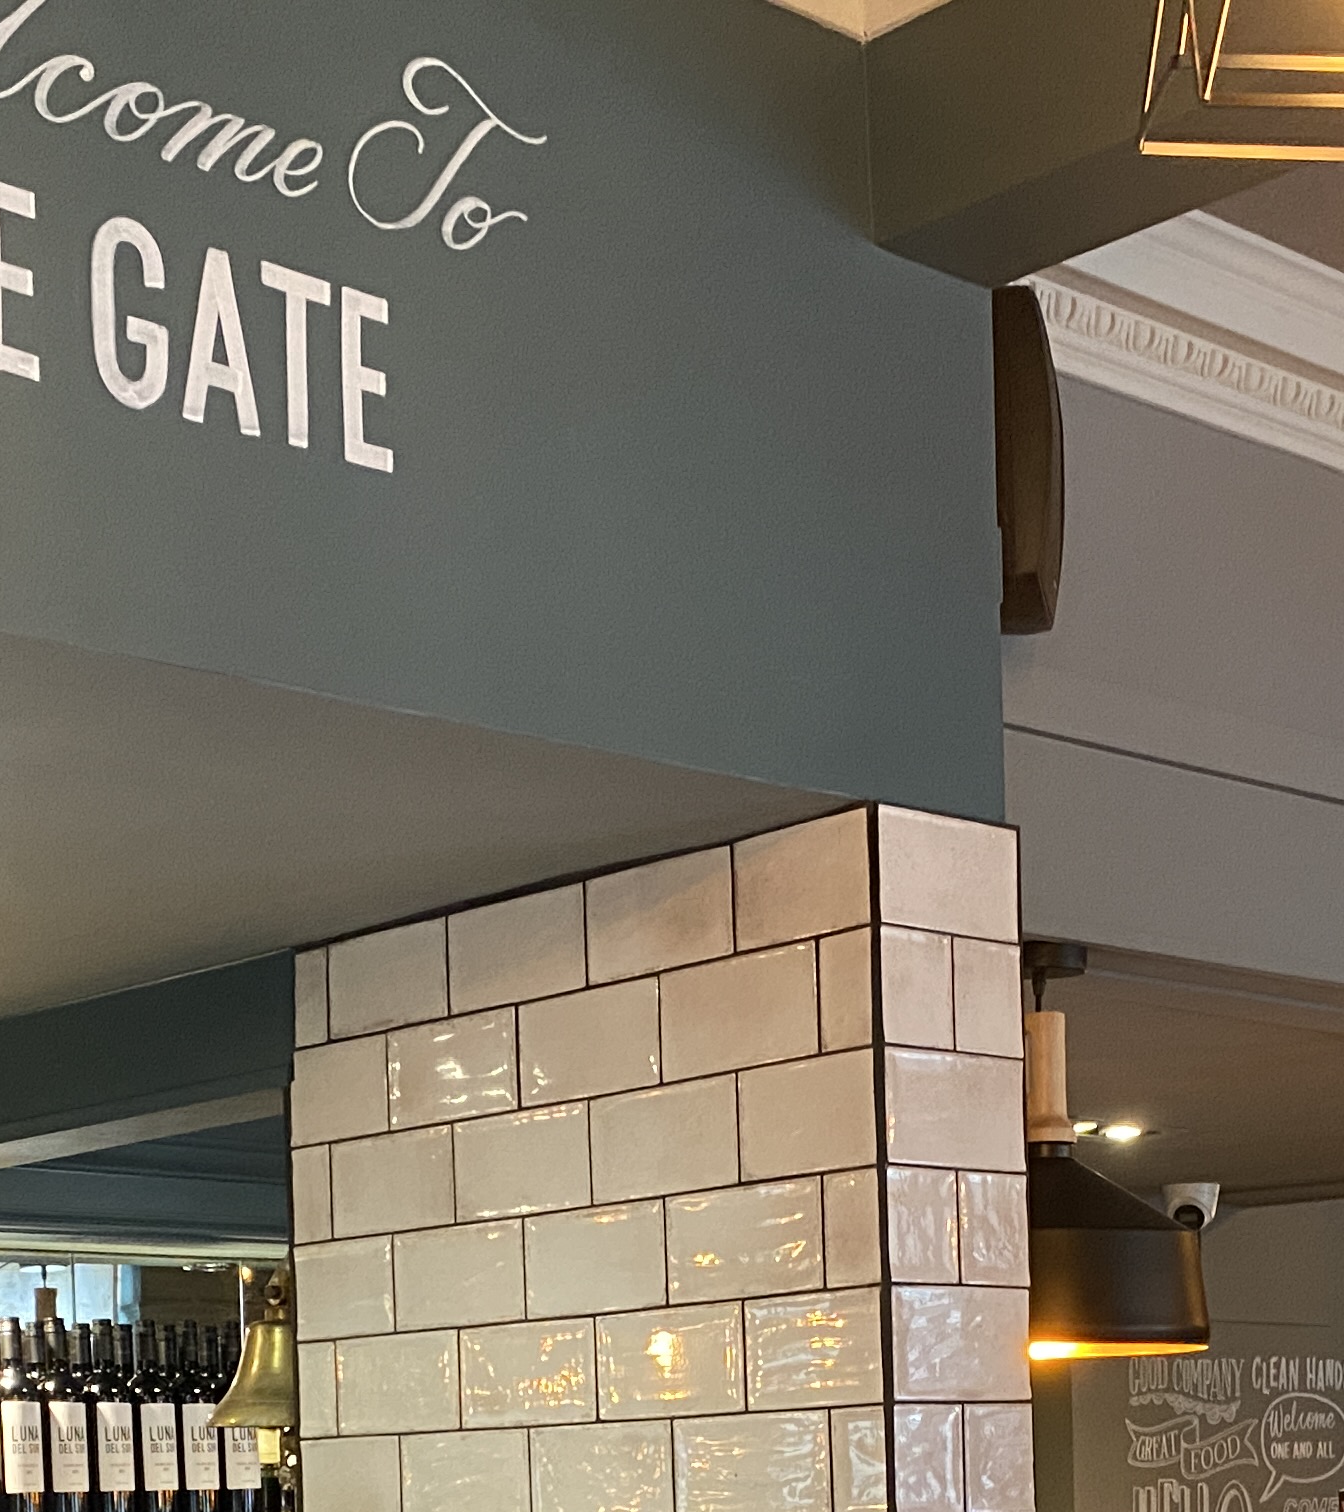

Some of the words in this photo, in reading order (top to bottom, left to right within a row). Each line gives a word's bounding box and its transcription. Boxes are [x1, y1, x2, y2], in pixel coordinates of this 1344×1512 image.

[347, 56, 548, 250] To
[90, 216, 394, 473] GATE
[1129, 1356, 1168, 1394] GOOD
[1172, 1358, 1244, 1400] COMPANY
[1252, 1356, 1299, 1394] CLEAN
[11, 1425, 39, 1442] LUNA
[58, 1425, 85, 1442] LUNA
[1267, 1400, 1335, 1437] Welcome
[12, 1443, 27, 1455] DEL
[58, 1443, 73, 1455] DEL
[106, 1443, 119, 1454] DEL
[1136, 1430, 1178, 1460] GREAT
[1191, 1435, 1240, 1472] FOOD
[1270, 1441, 1290, 1459] ONE
[1292, 1441, 1312, 1459] AND
[1316, 1440, 1335, 1458] ALL
